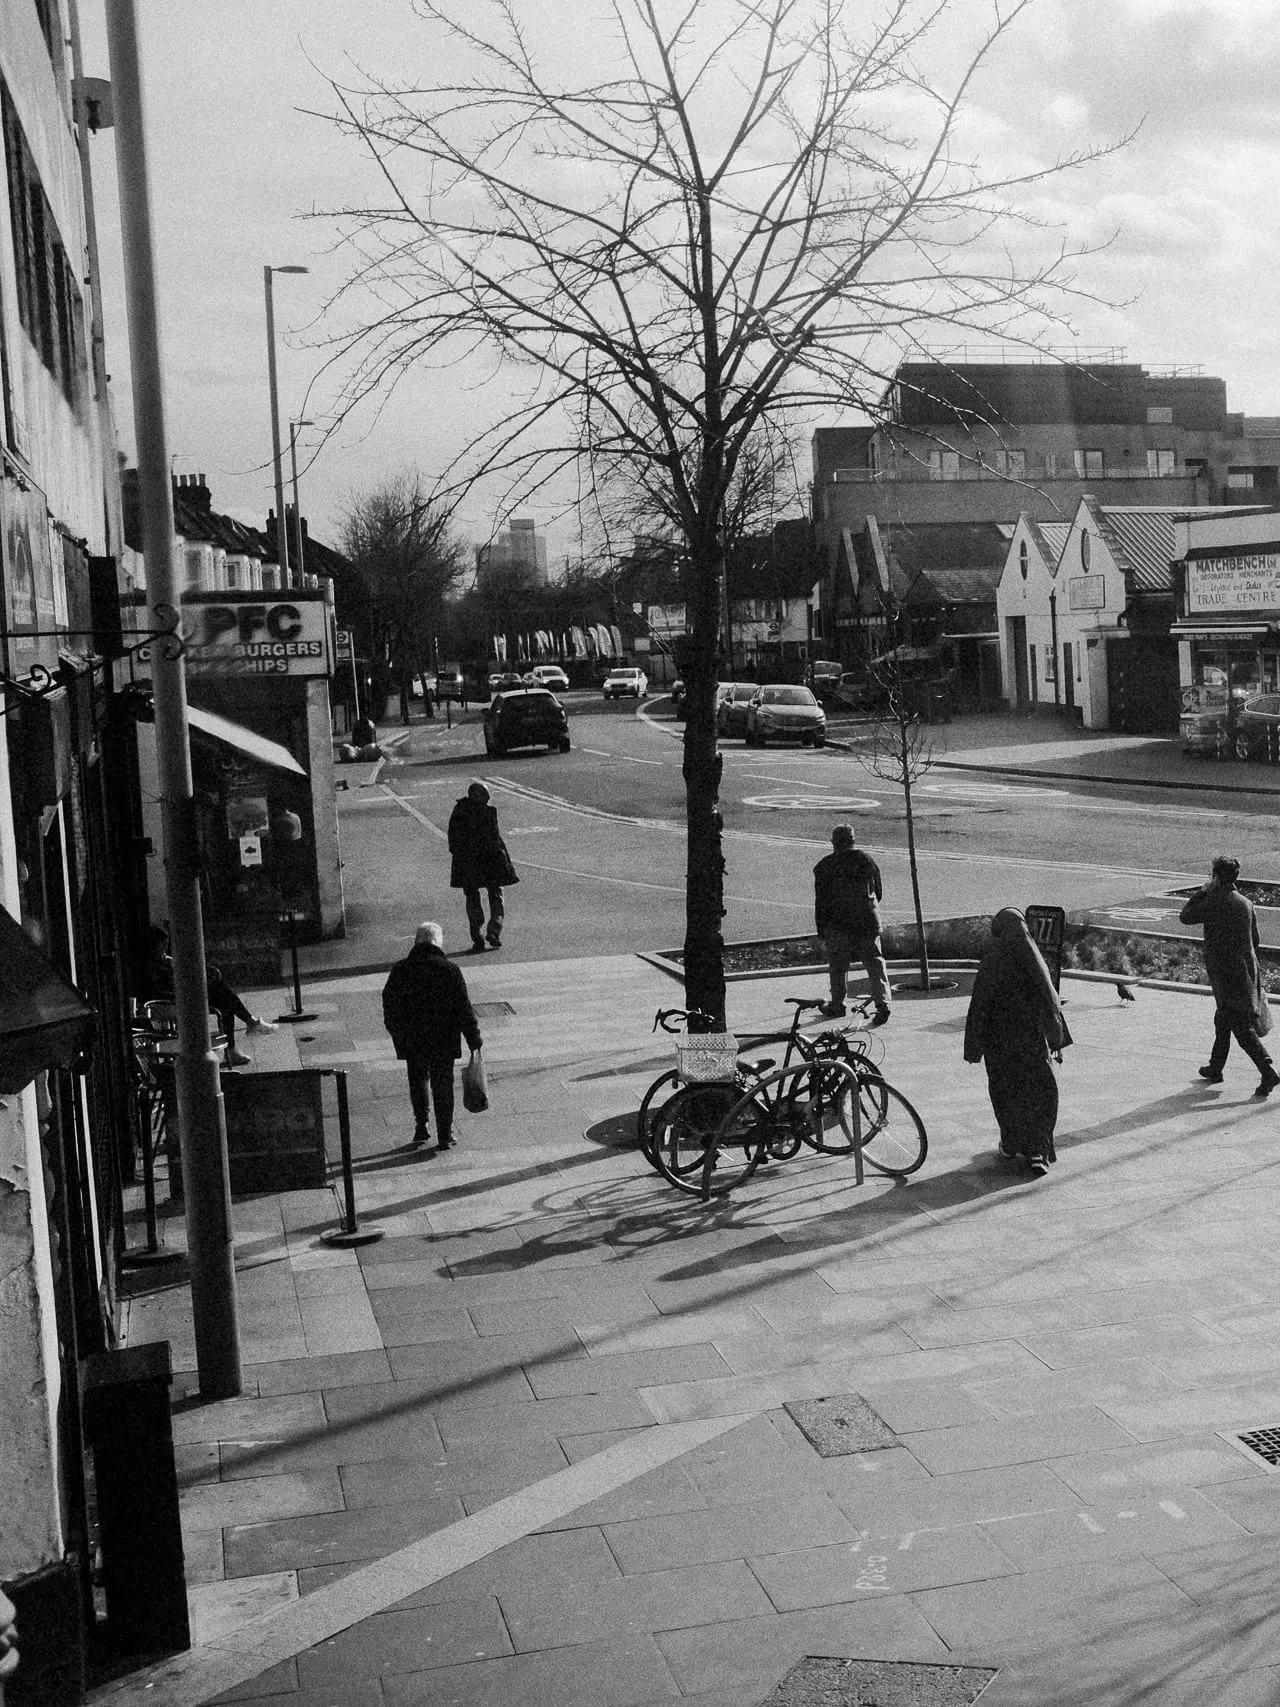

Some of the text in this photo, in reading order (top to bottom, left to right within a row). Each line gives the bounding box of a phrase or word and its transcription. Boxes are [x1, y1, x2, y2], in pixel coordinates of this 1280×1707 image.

[1196, 556, 1266, 572] MATCHBENCH
[1200, 569, 1273, 580] DECORATORS MERCHANTS
[1246, 581, 1262, 590] Dulux
[1197, 591, 1276, 605] TRADE CENTRE
[204, 604, 302, 643] PFC
[234, 643, 321, 657] BURGERS
